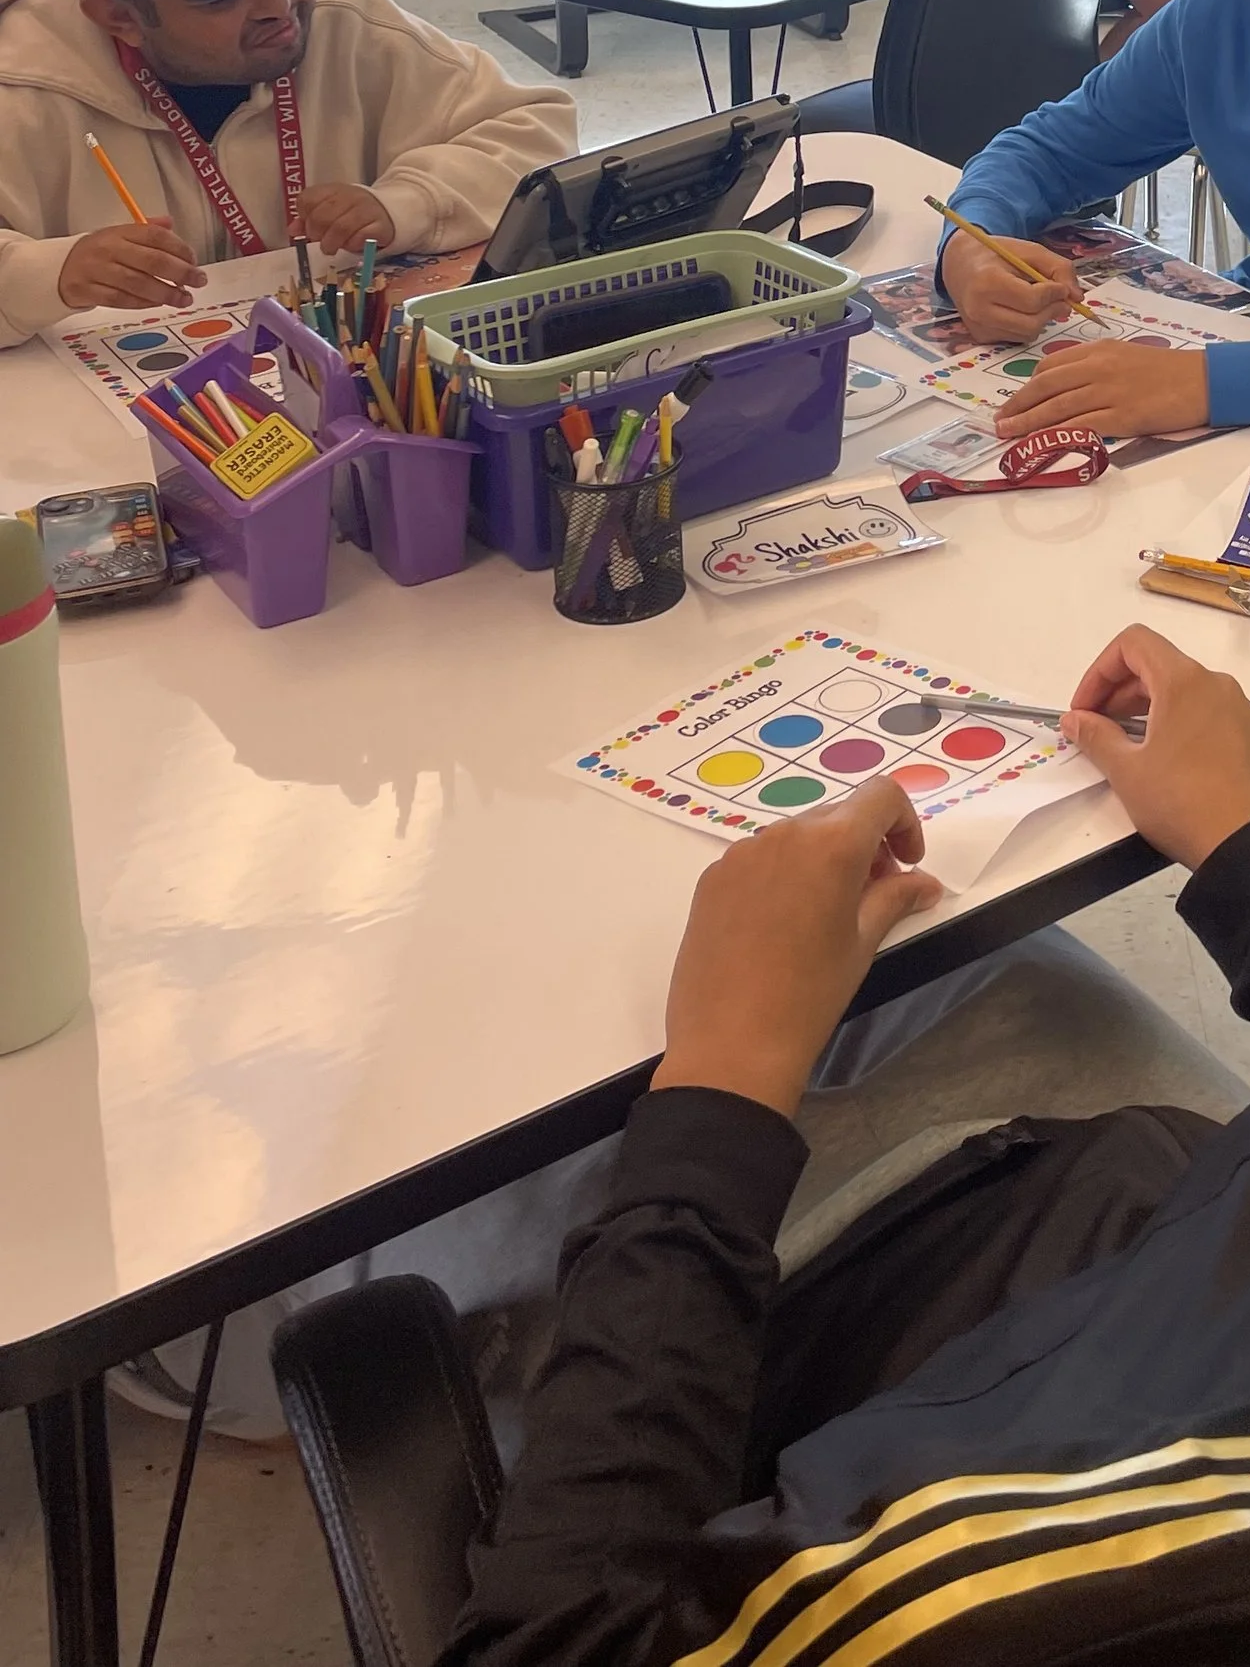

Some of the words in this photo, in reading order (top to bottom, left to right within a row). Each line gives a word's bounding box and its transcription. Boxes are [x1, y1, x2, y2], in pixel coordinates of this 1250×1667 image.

[135, 68, 200, 154] WILDCATS
[276, 75, 295, 122] WILD
[194, 155, 254, 245] WHEATLEY
[226, 425, 282, 472] ERASER
[243, 440, 295, 483] MAGNETIC
[1016, 430, 1101, 460] WILDCA
[754, 527, 861, 563] Shakshi
[677, 708, 731, 738] Color
[723, 679, 783, 711] Bingo
